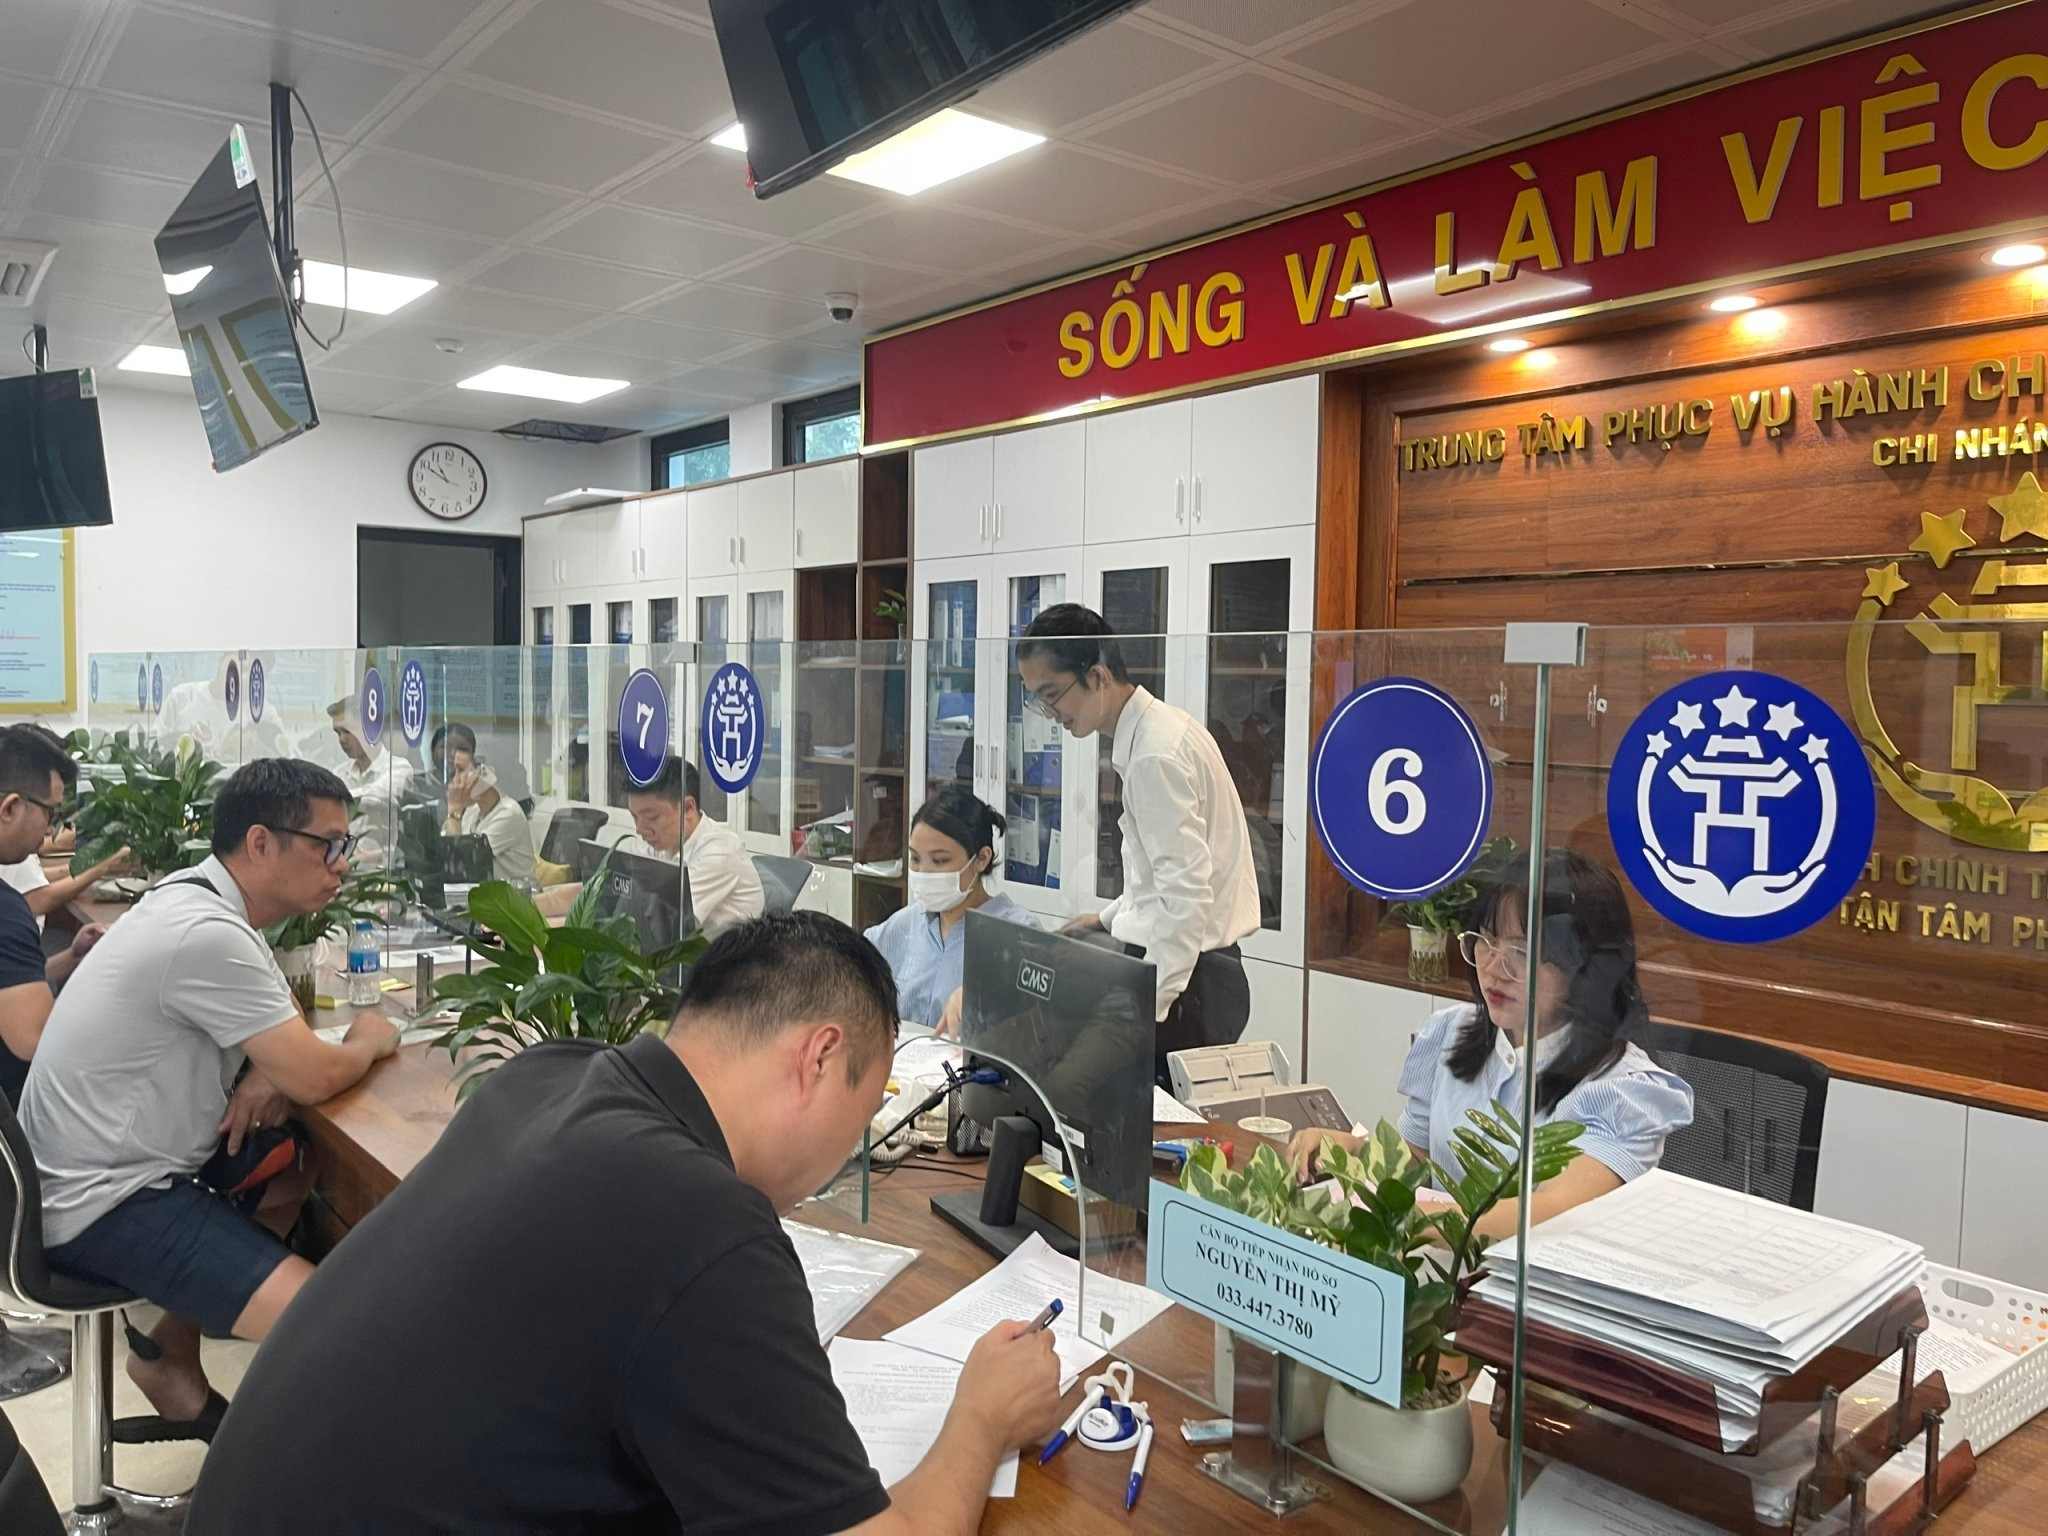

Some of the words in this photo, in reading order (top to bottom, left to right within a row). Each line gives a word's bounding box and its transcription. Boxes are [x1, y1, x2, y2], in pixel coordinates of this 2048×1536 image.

[1057, 264, 1246, 379] SỐNG
[1286, 211, 1392, 326] VÀ
[1434, 156, 1659, 297] LÀM
[1720, 53, 2048, 223] VIỆC
[1402, 427, 1506, 473] TRUNG
[1518, 413, 1587, 456] TÂM
[1604, 398, 1714, 450] PHỤC
[1730, 386, 1793, 437] VỤ
[1812, 366, 1949, 421] HÀNH
[1968, 355, 2044, 401] CH
[1872, 433, 1938, 467] CHI
[1955, 416, 2048, 460] NHÁN
[229, 676, 237, 703] 9
[368, 688, 378, 722] 8
[636, 701, 654, 750] 7
[1368, 748, 1427, 835] 6
[1896, 853, 2009, 895] CHÍNH
[2024, 866, 2048, 899] T
[1839, 891, 1901, 935] TẬN
[1917, 902, 1991, 944] TÂM
[1020, 966, 1050, 993] CMS
[1196, 1240, 1267, 1286] NGUYỄN
[1272, 1273, 1305, 1307] THỊ
[1224, 1233, 1239, 1249] BỘ
[1268, 1250, 1299, 1273] NHẬN
[1322, 1274, 1338, 1289] SƠ
[1217, 1282, 1313, 1340] 033.447.3780
